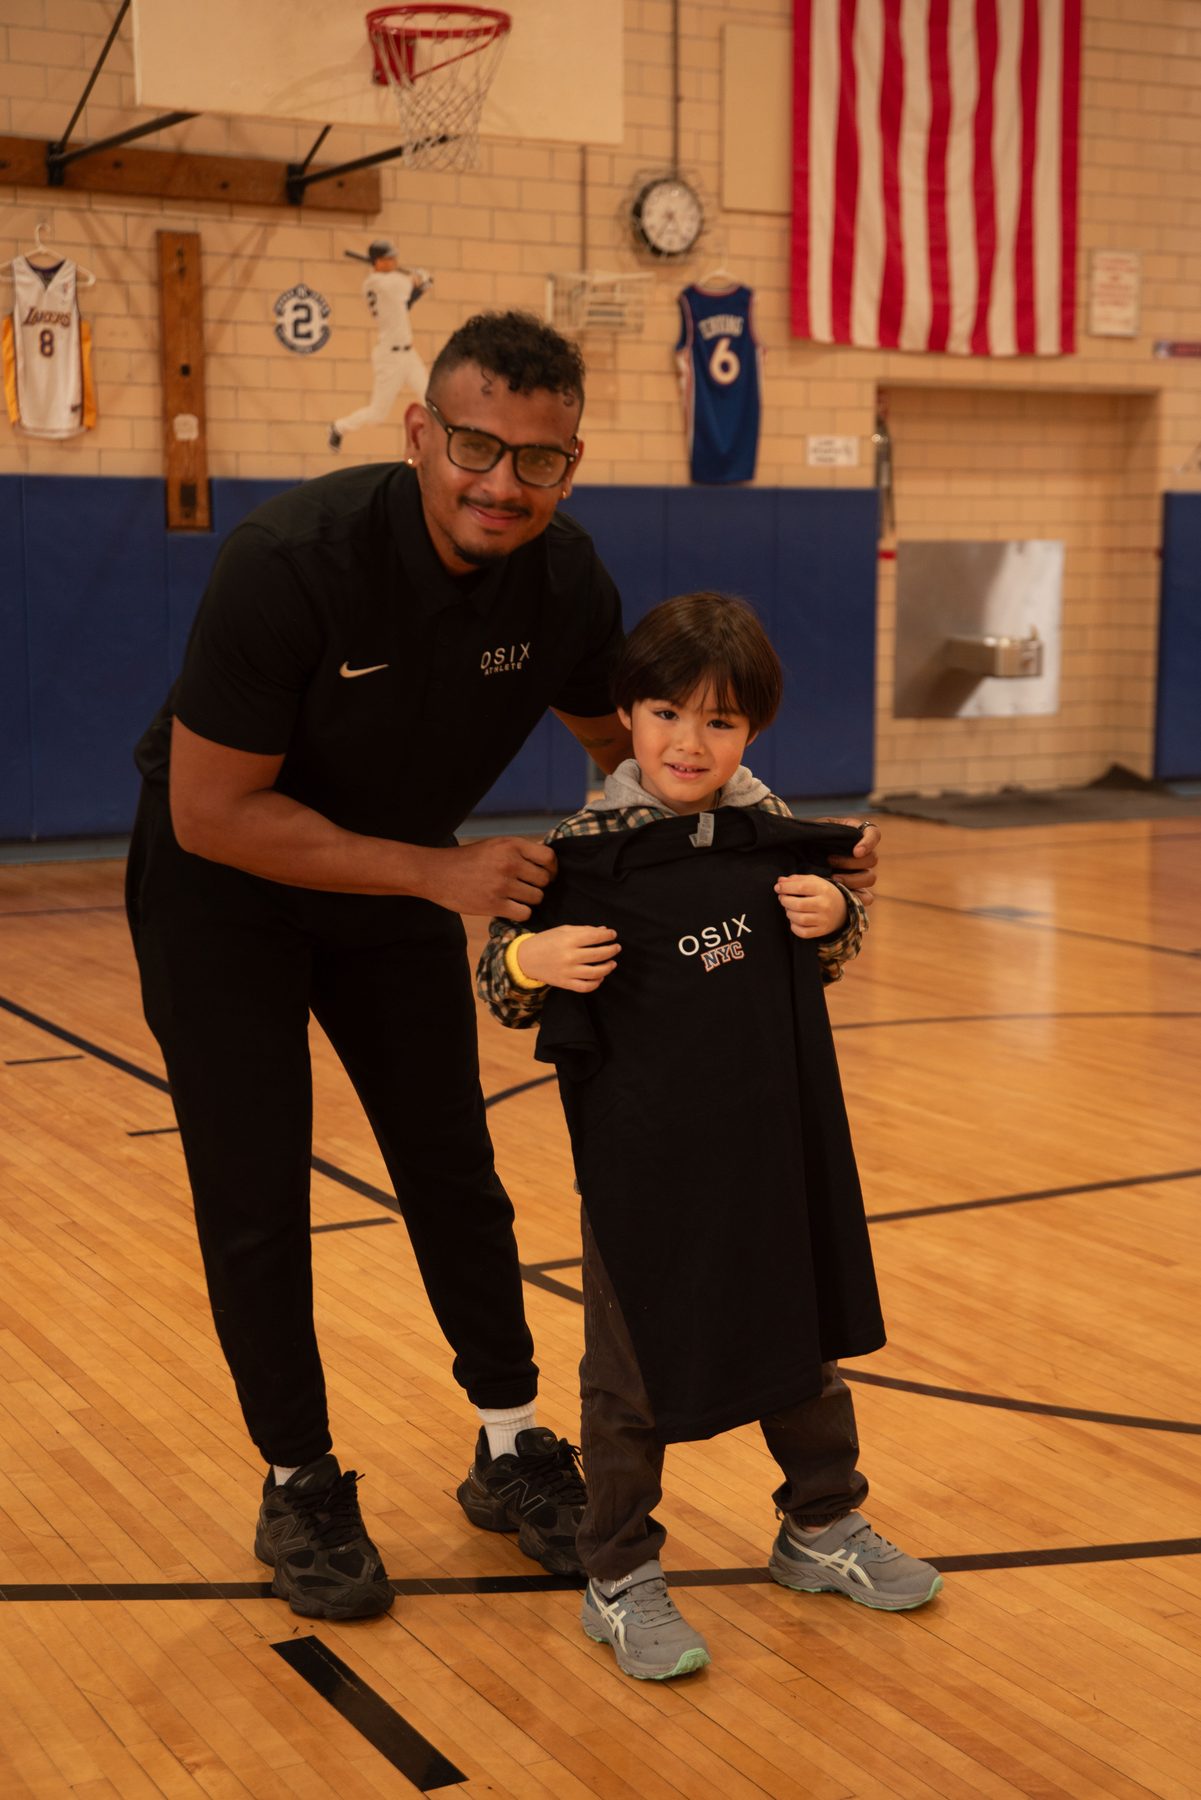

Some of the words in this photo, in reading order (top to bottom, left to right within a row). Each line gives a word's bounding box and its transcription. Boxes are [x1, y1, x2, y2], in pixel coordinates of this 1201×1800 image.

[292, 303, 312, 339] 2
[40, 328, 55, 358] 8
[709, 336, 740, 385] 6
[480, 641, 530, 670] OSIX
[484, 661, 522, 676] ATHLETE
[678, 913, 752, 956] OSIX
[700, 940, 745, 972] NYC
